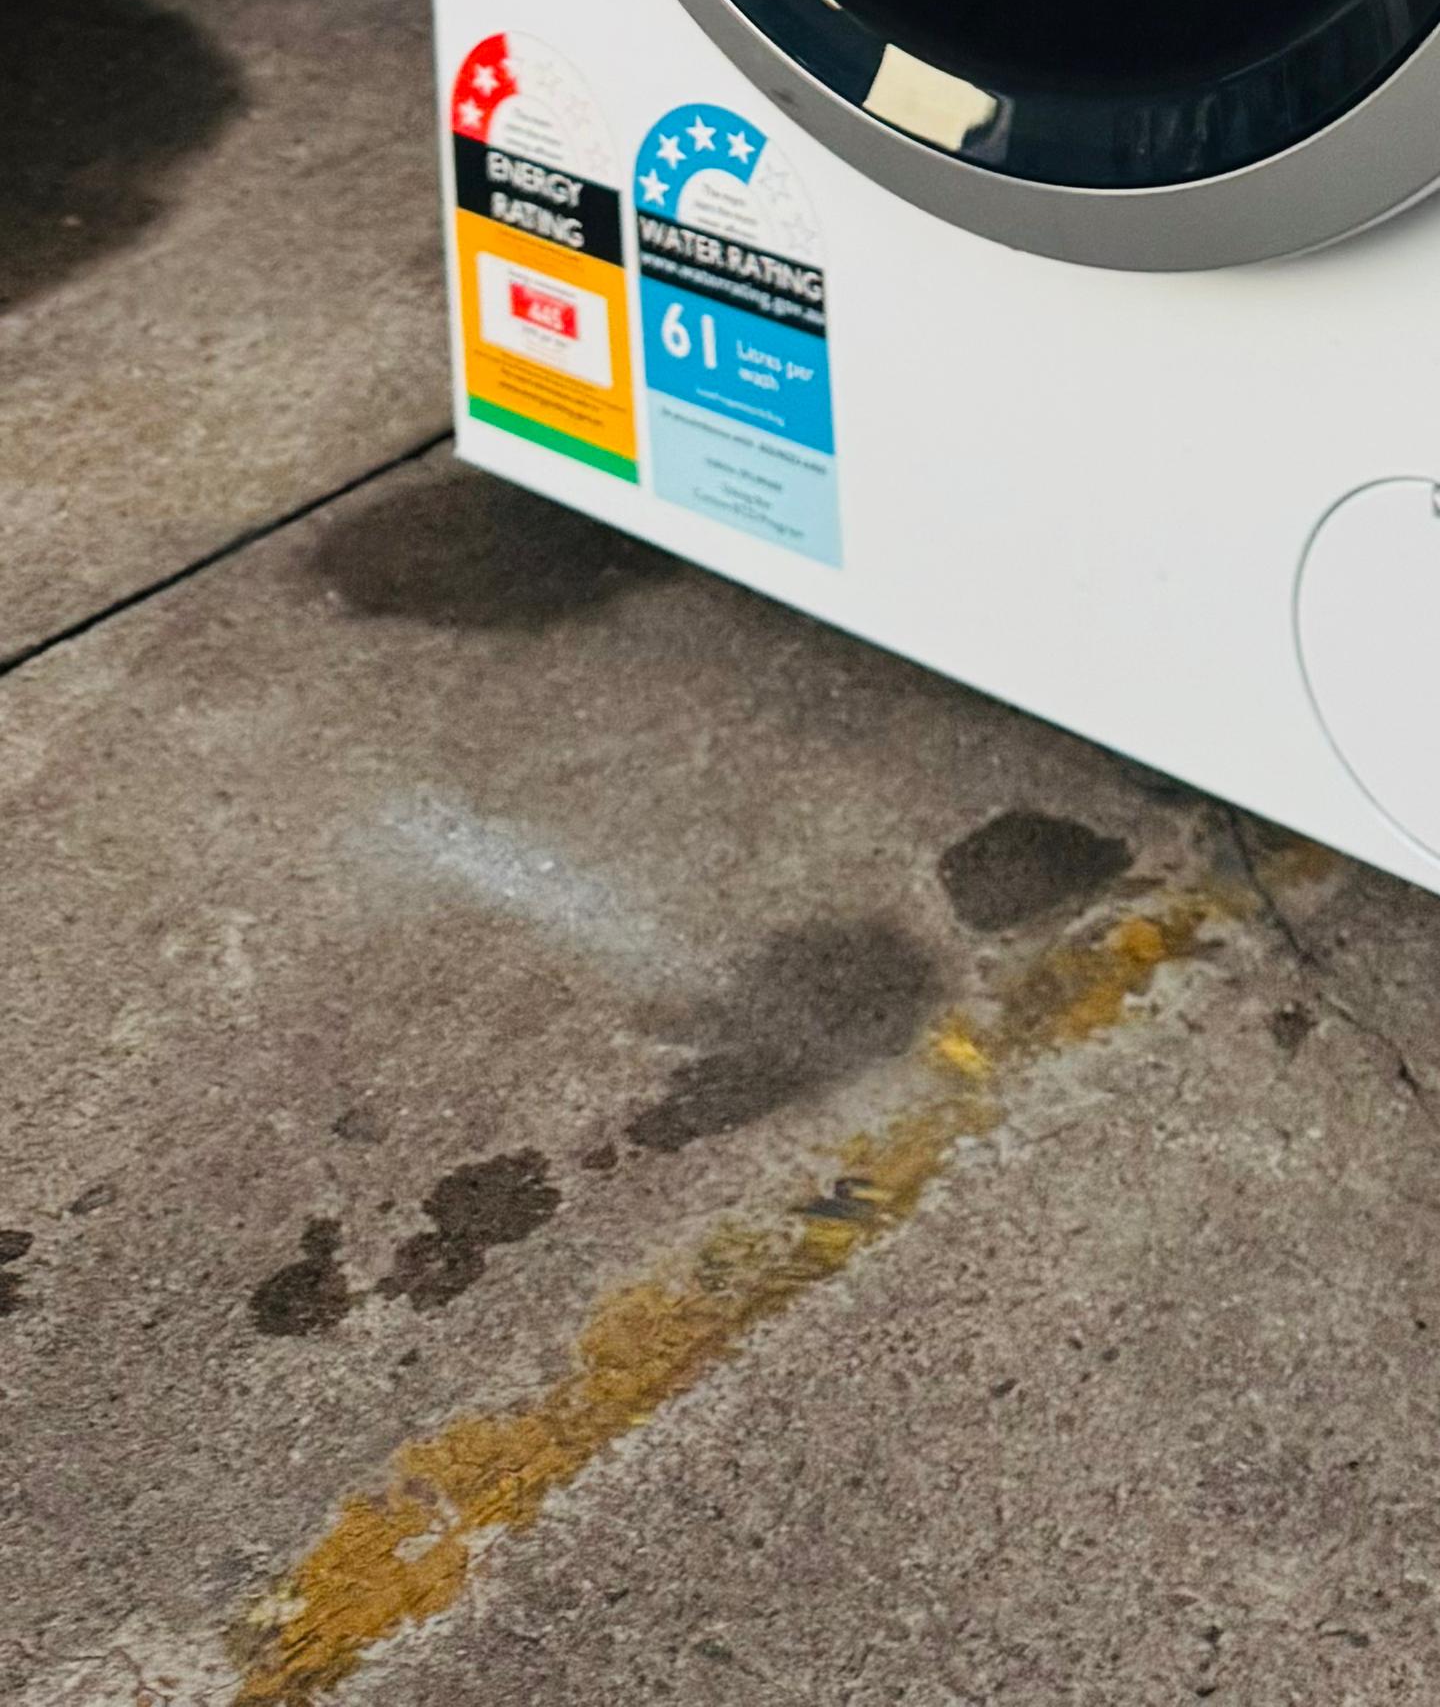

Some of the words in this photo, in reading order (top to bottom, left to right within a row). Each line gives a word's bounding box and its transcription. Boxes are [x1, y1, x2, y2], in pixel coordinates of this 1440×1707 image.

[486, 150, 584, 209] ENERGY
[490, 191, 585, 249] RATING
[638, 215, 724, 269] WATER
[726, 245, 824, 303] RATING
[785, 360, 816, 382] per
